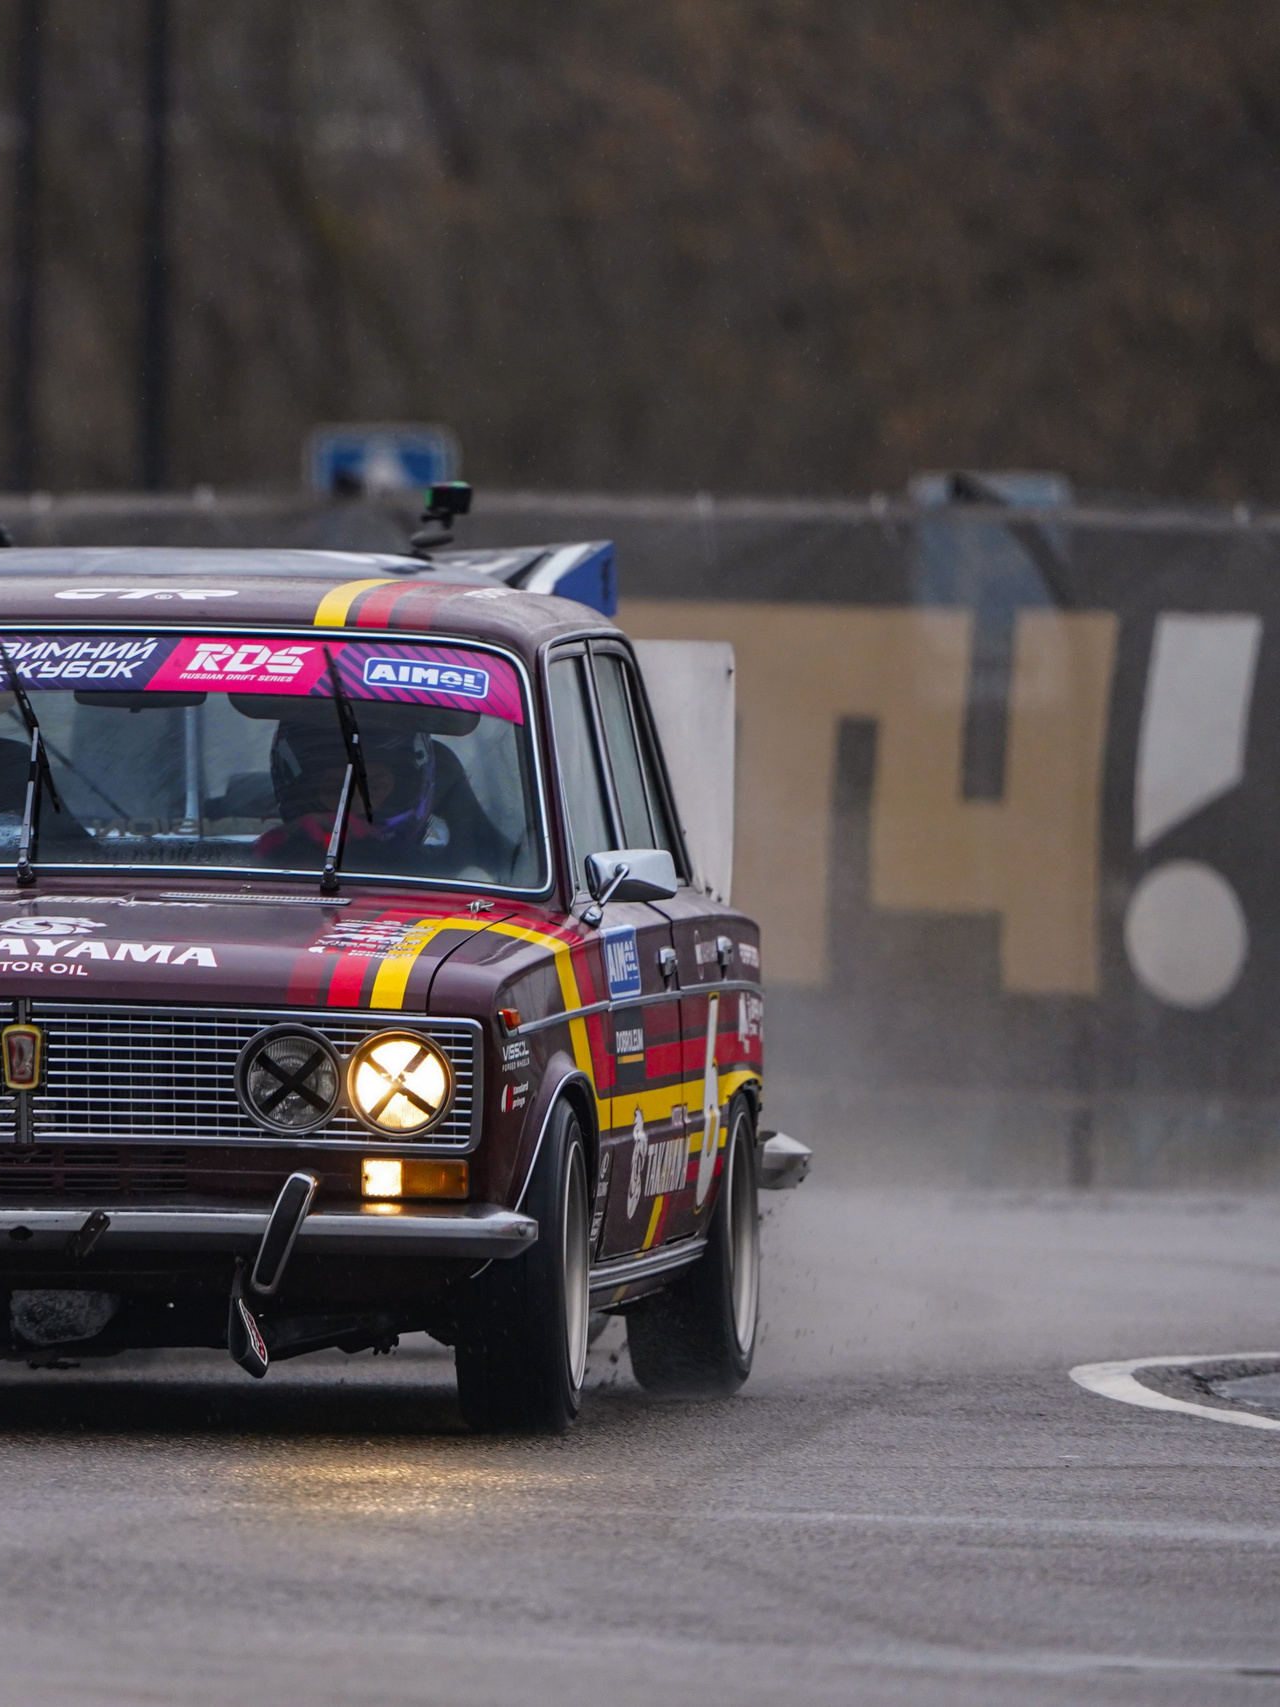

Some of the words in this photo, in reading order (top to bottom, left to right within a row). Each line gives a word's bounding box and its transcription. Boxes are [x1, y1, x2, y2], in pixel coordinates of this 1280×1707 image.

[186, 643, 315, 671] RDS
[16, 660, 145, 680] КУБОК
[179, 672, 221, 680] RUSSIAN
[223, 673, 257, 681] DRIFT
[258, 674, 294, 682] SERIES
[370, 664, 482, 693] AIMOL
[617, 603, 1264, 1012] ТЧ!
[49, 963, 88, 976] OIL
